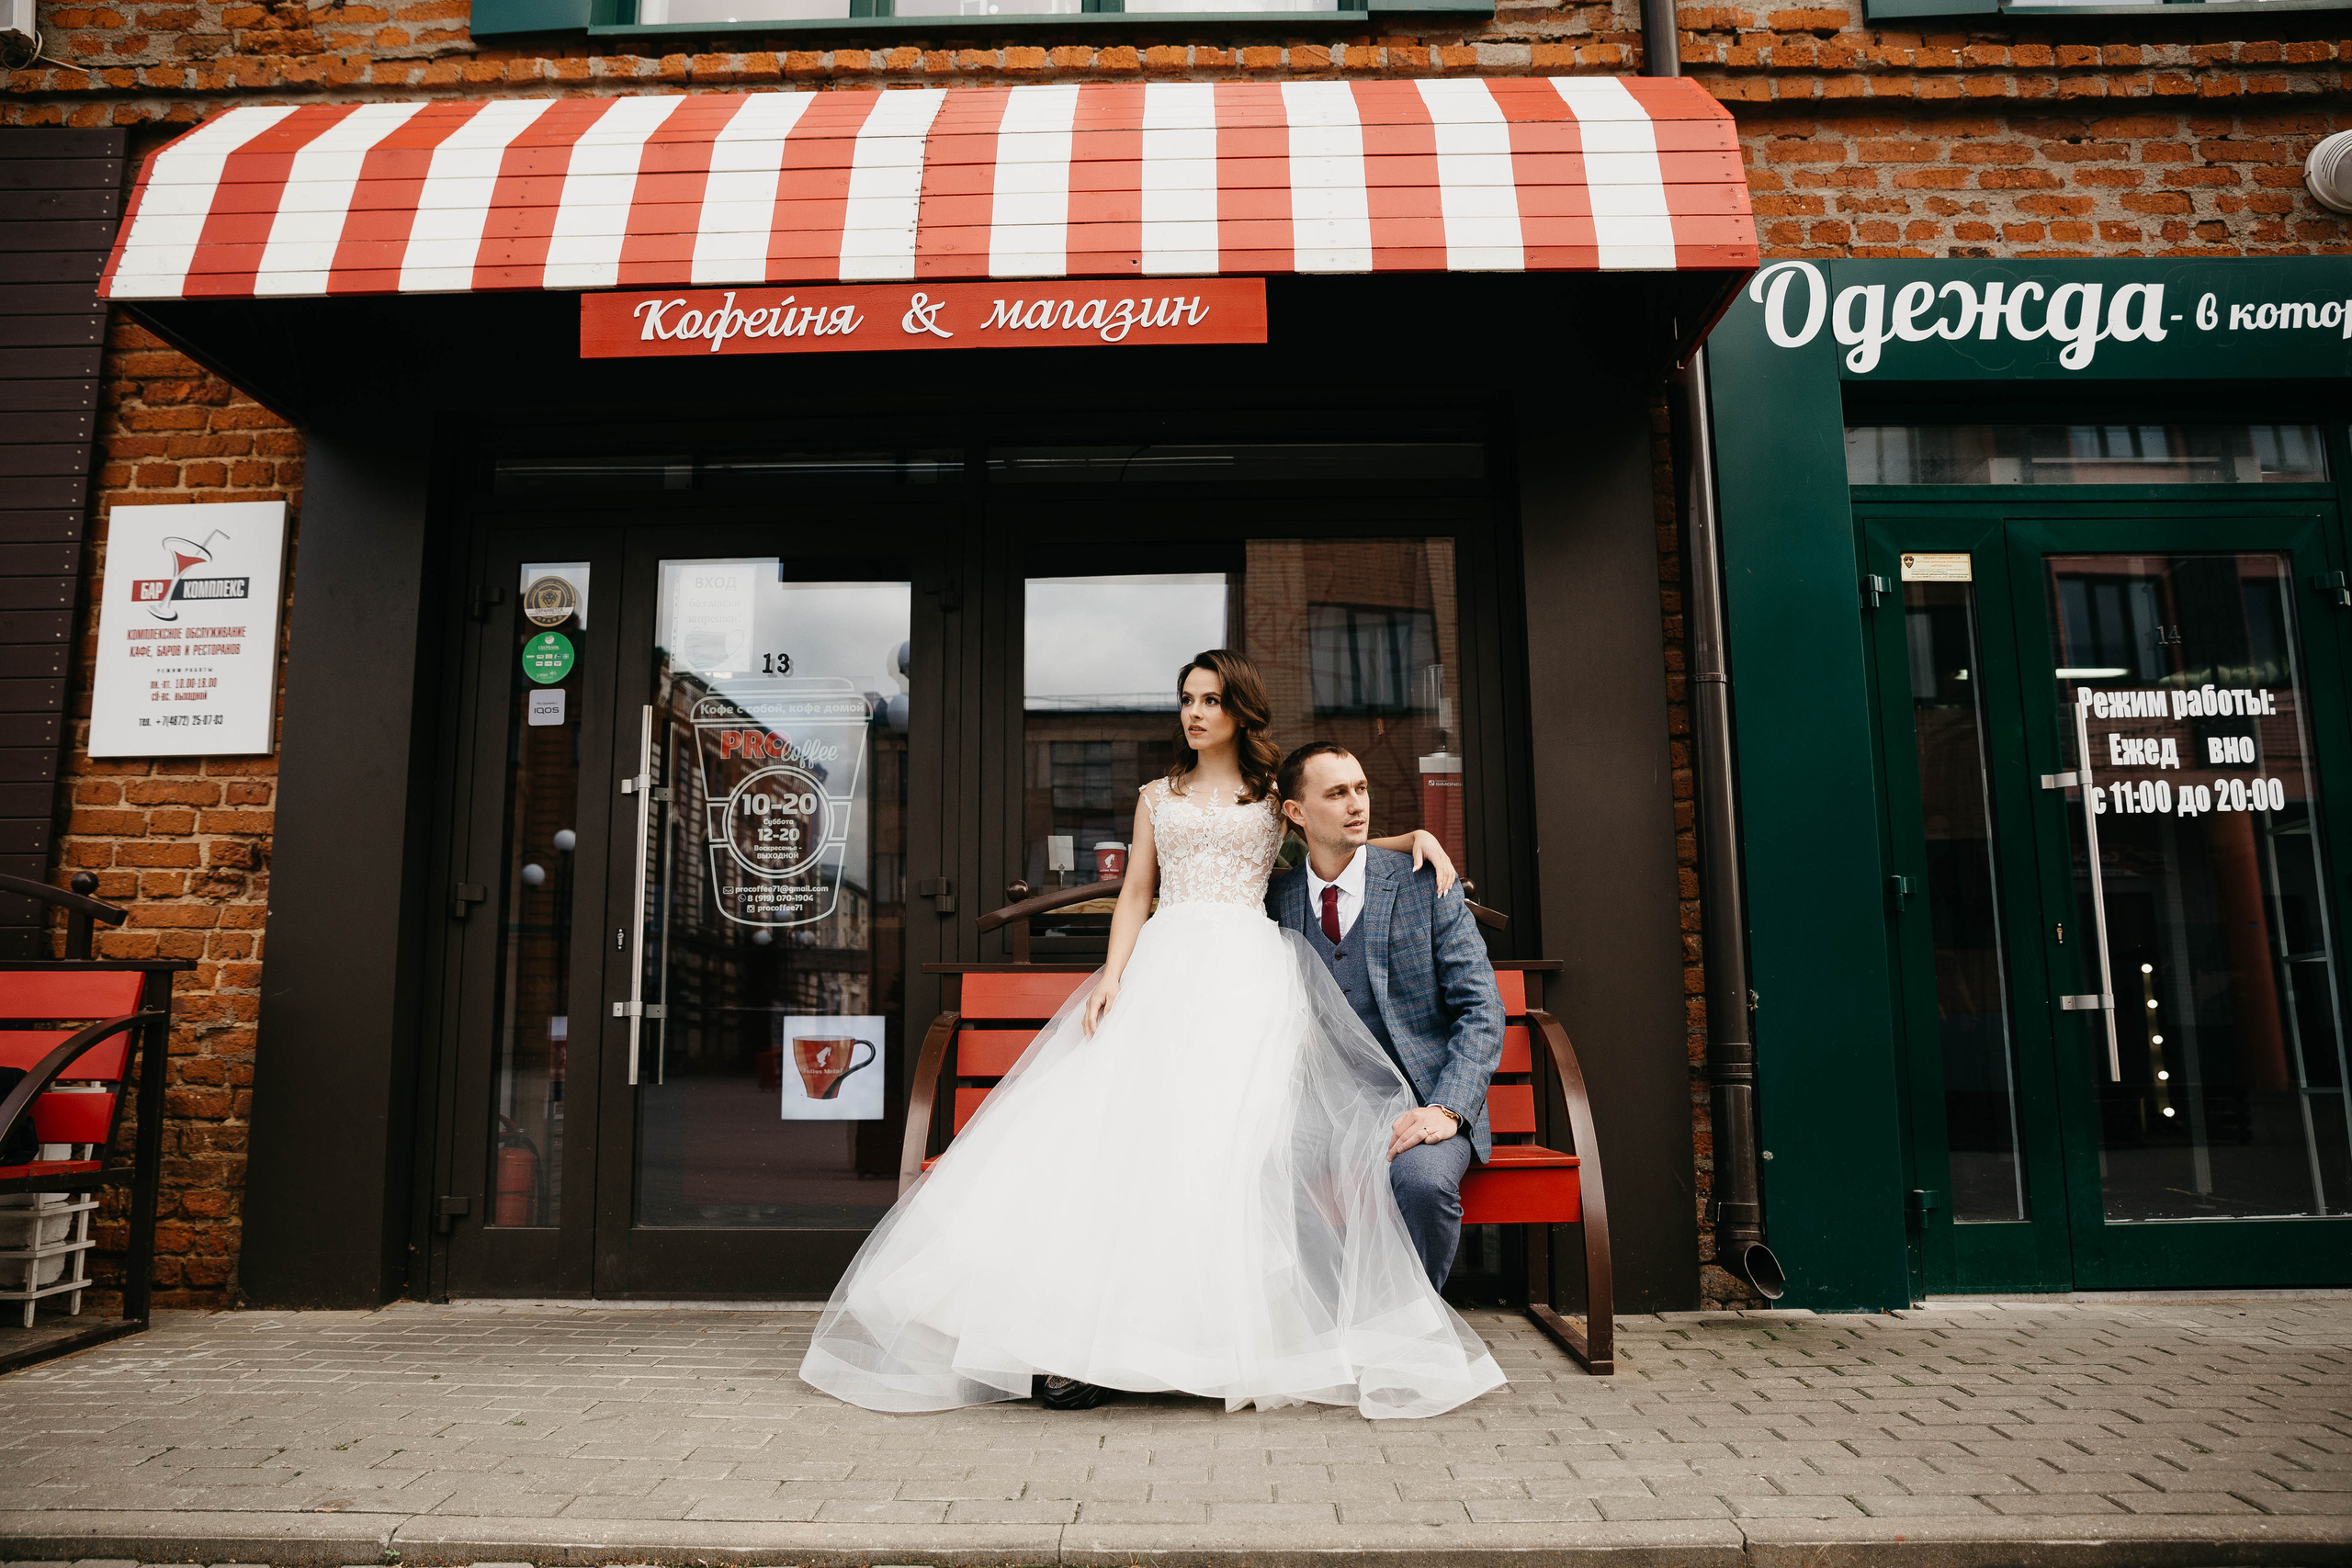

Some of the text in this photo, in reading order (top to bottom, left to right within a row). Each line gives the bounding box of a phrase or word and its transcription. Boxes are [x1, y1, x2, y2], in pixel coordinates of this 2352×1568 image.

[2196, 292, 2219, 331] в
[633, 291, 1211, 353] Кофейня & магазин
[140, 580, 245, 600] БАР КОМПЛЕКС
[695, 576, 738, 592] ВХОД
[689, 598, 706, 608] без
[127, 626, 247, 640] КОМПЛЕКСНОЕ ОБСЛУЖИВАНИЕ
[2156, 625, 2181, 644] 14
[130, 643, 242, 659] КАФЕ, БАРОВ И РЕСТОРАНОВ
[762, 652, 791, 674] 13
[700, 701, 865, 716] Кофе с собой, кофе домой
[2077, 683, 2277, 720] Режим работы:
[534, 706, 560, 715] IQOS
[720, 729, 792, 760] PRO
[741, 793, 818, 816] 10-20
[2092, 778, 2285, 818] с 11:00 до 20:00
[763, 818, 794, 827] Суббота
[757, 828, 800, 841] 12-20
[757, 851, 799, 860] ВЫХОДНОЙ
[735, 886, 829, 894] procoffee71@gmail.com
[754, 894, 775, 903] (919)
[776, 894, 814, 902] 070-1904
[757, 904, 803, 912] procoffee71
